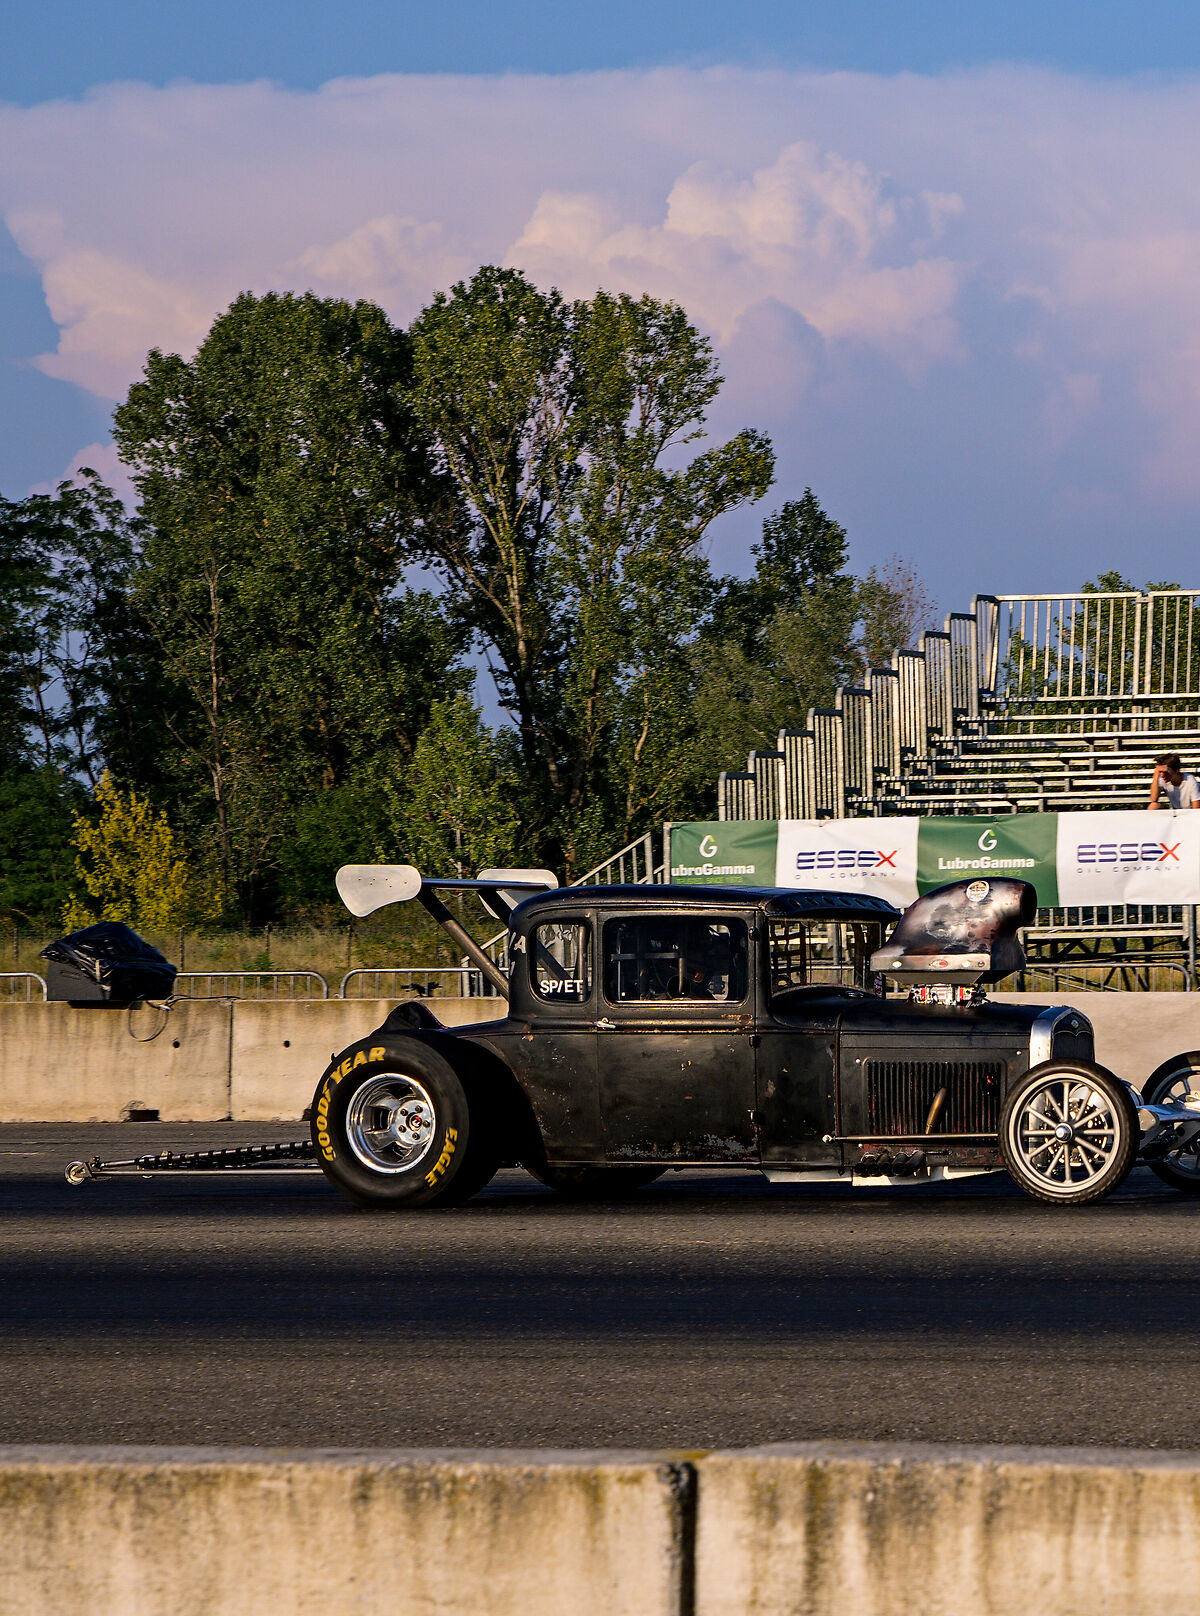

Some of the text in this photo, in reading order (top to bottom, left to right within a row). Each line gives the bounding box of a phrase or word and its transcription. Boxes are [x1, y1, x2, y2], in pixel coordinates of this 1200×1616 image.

[796, 850, 898, 870] ESSEX
[1077, 842, 1181, 863] ESSEX
[671, 863, 755, 876] ubroGamma
[938, 856, 1035, 870] LubroGamma
[540, 980, 584, 994] SP/ET
[424, 1127, 458, 1188] EAGLE
